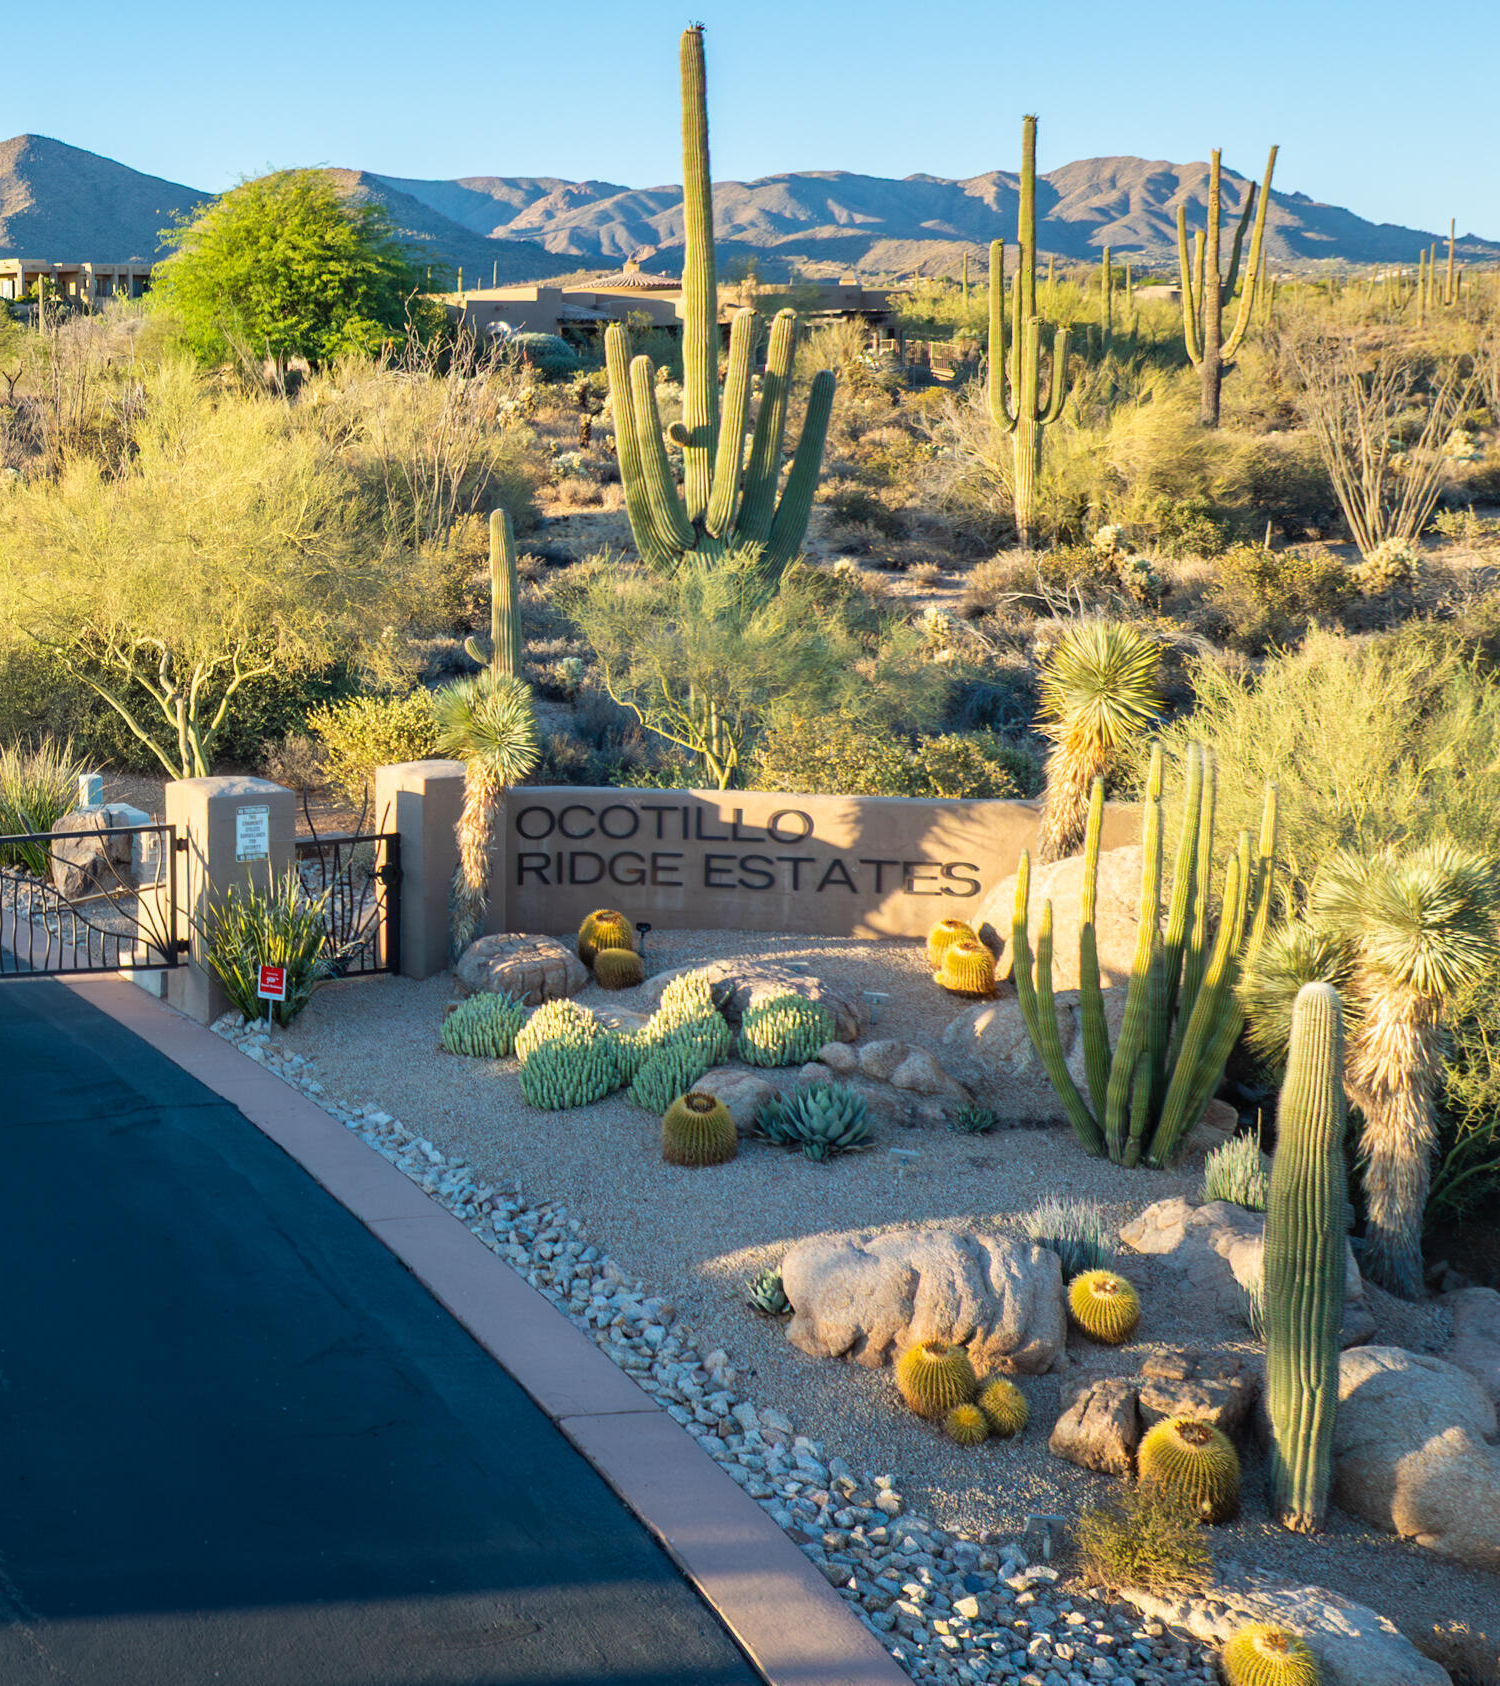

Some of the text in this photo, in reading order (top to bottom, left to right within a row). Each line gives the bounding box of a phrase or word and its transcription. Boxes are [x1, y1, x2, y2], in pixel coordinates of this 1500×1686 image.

[515, 804, 815, 845] OCOTILLO
[516, 851, 982, 898] RIDGE ESTATES
